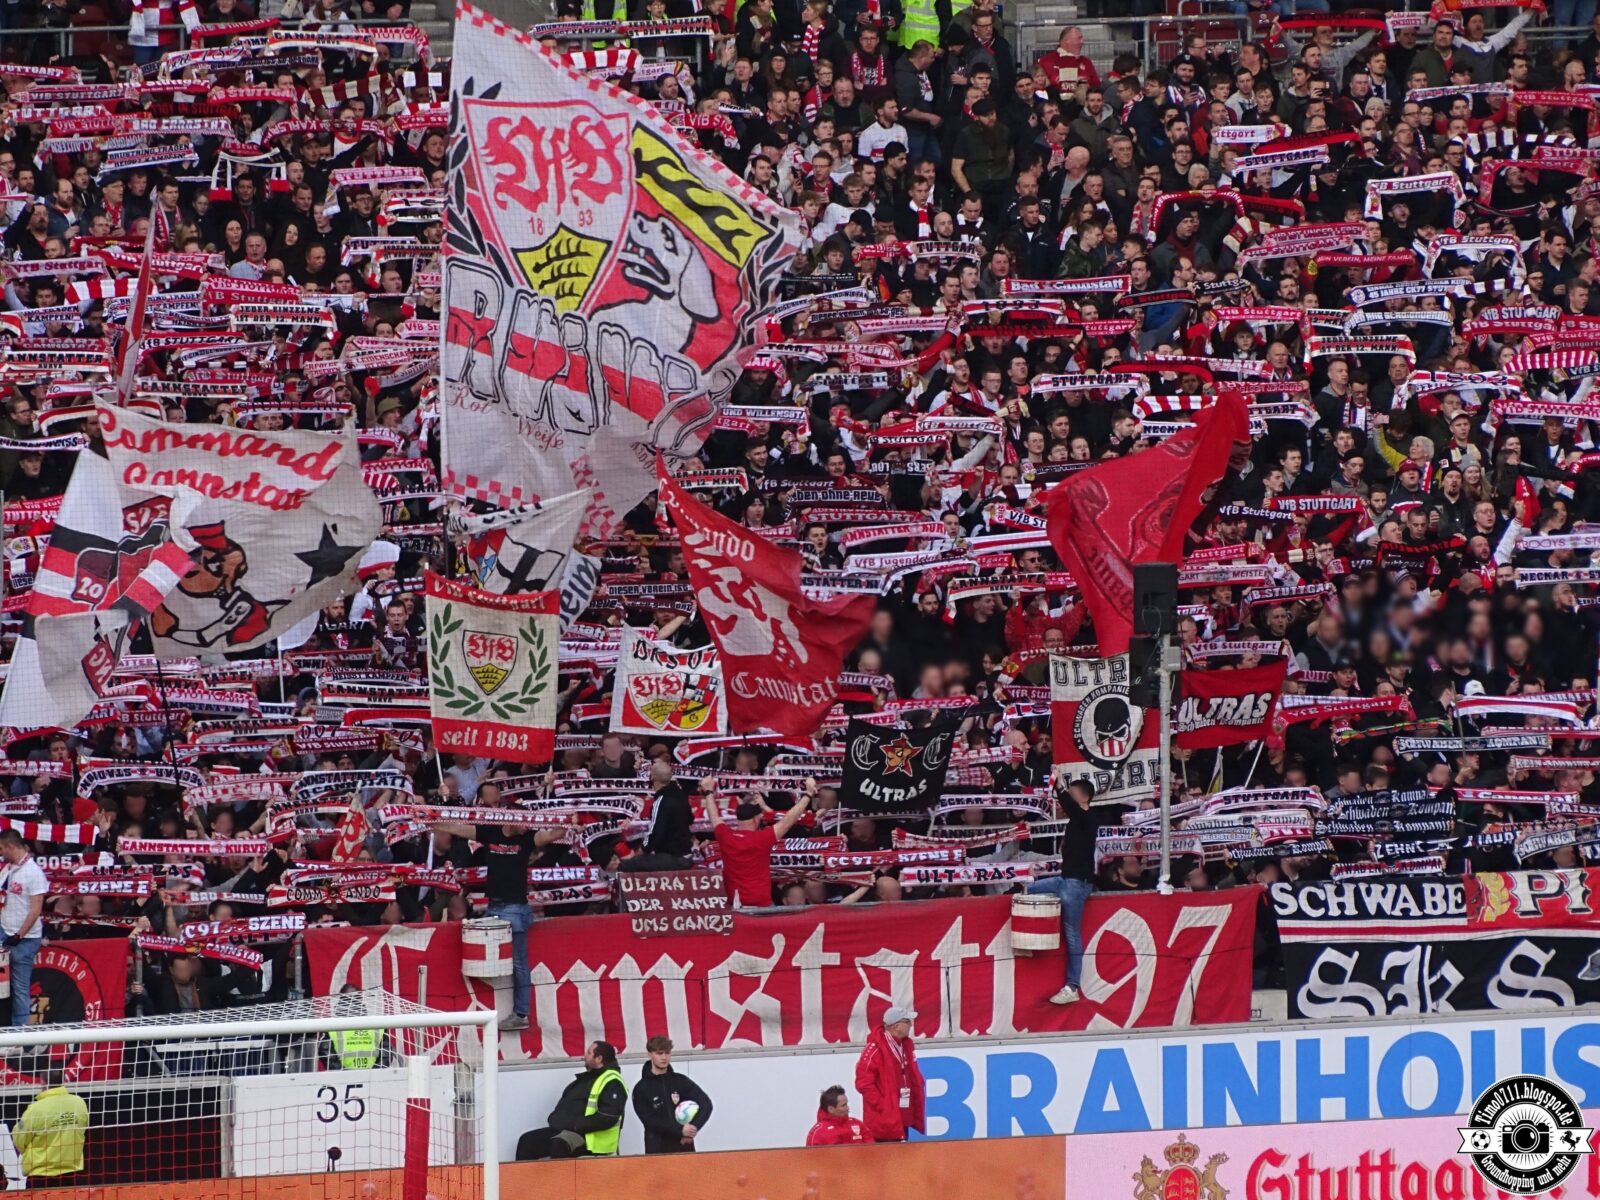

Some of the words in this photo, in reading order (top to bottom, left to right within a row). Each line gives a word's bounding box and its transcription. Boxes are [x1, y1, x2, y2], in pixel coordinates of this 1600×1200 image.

[0, 64, 64, 77] TUTTGART
[1244, 148, 1319, 167] STUTTGART
[528, 216, 544, 236] 18
[577, 208, 595, 229] 93
[1203, 278, 1246, 290] Stuttga
[7, 352, 104, 364] ANNSTATTER
[1051, 373, 1133, 387] STUTTGART
[722, 407, 744, 416] UND
[1248, 404, 1300, 415] TTGART
[97, 407, 344, 482] Command
[1298, 498, 1358, 511] STUTTGART
[841, 524, 911, 543] ANNSTATTER
[78, 576, 105, 597] 20
[1221, 641, 1279, 652] Stuttgart
[1052, 657, 1128, 687] ULTR
[1178, 692, 1273, 723] ULTRAS
[485, 728, 530, 752] 1893
[859, 777, 929, 803] ULTRAS
[1223, 790, 1311, 805] STUTTGART
[121, 840, 211, 853] CANNSTATTER
[225, 843, 268, 854] KURVE
[37, 856, 73, 870] 905
[531, 868, 584, 881] SZENE
[78, 880, 133, 894] SZENE
[628, 898, 665, 912] DER
[1269, 881, 1467, 918] SCHWABE
[248, 915, 306, 931] SZENE
[632, 916, 670, 933] UMS
[673, 914, 735, 932] GANZE
[1084, 903, 1232, 1031] 97
[315, 1083, 366, 1124] 35
